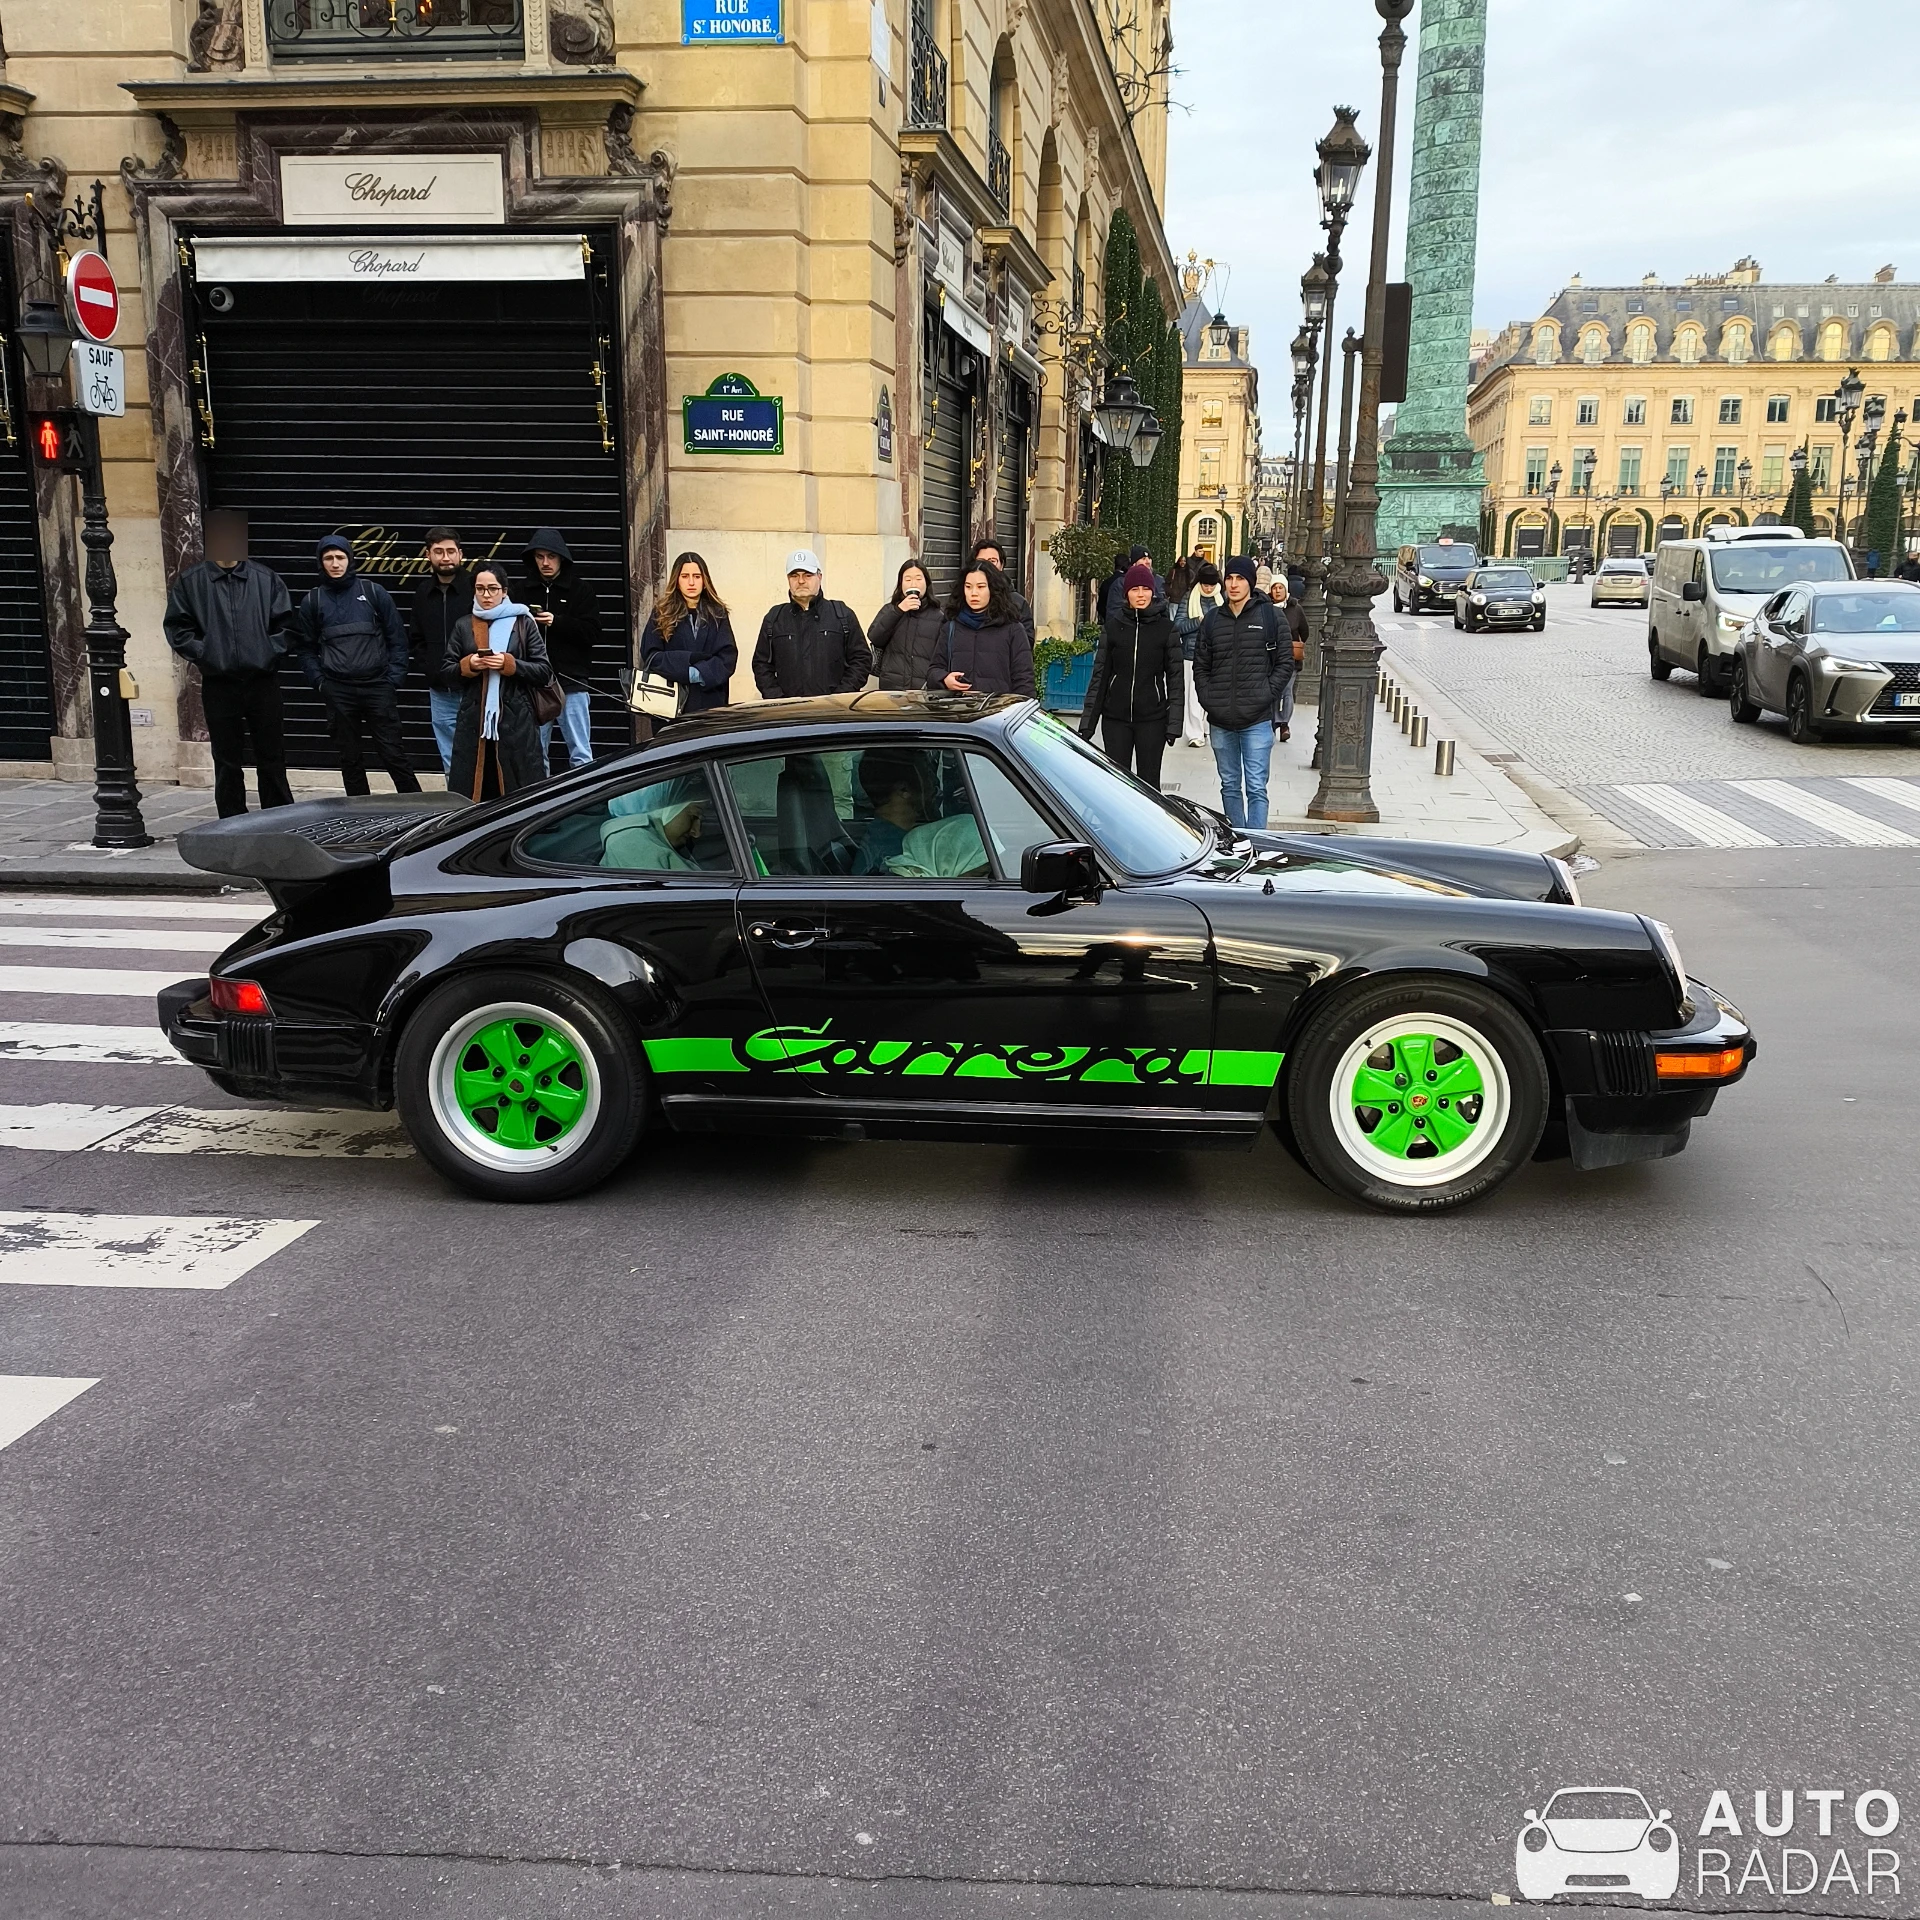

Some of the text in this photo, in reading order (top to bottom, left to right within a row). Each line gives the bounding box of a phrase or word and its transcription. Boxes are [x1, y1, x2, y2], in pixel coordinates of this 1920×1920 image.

[715, 0, 748, 14] RUE
[344, 172, 437, 207] Chopard
[348, 249, 425, 277] Chopard
[88, 347, 114, 367] SAUF
[721, 409, 744, 421] RUE
[693, 427, 774, 442] SAINT-HONORÉ
[731, 1018, 1209, 1084] Carrera
[1421, 1180, 1487, 1208] MICHELIN
